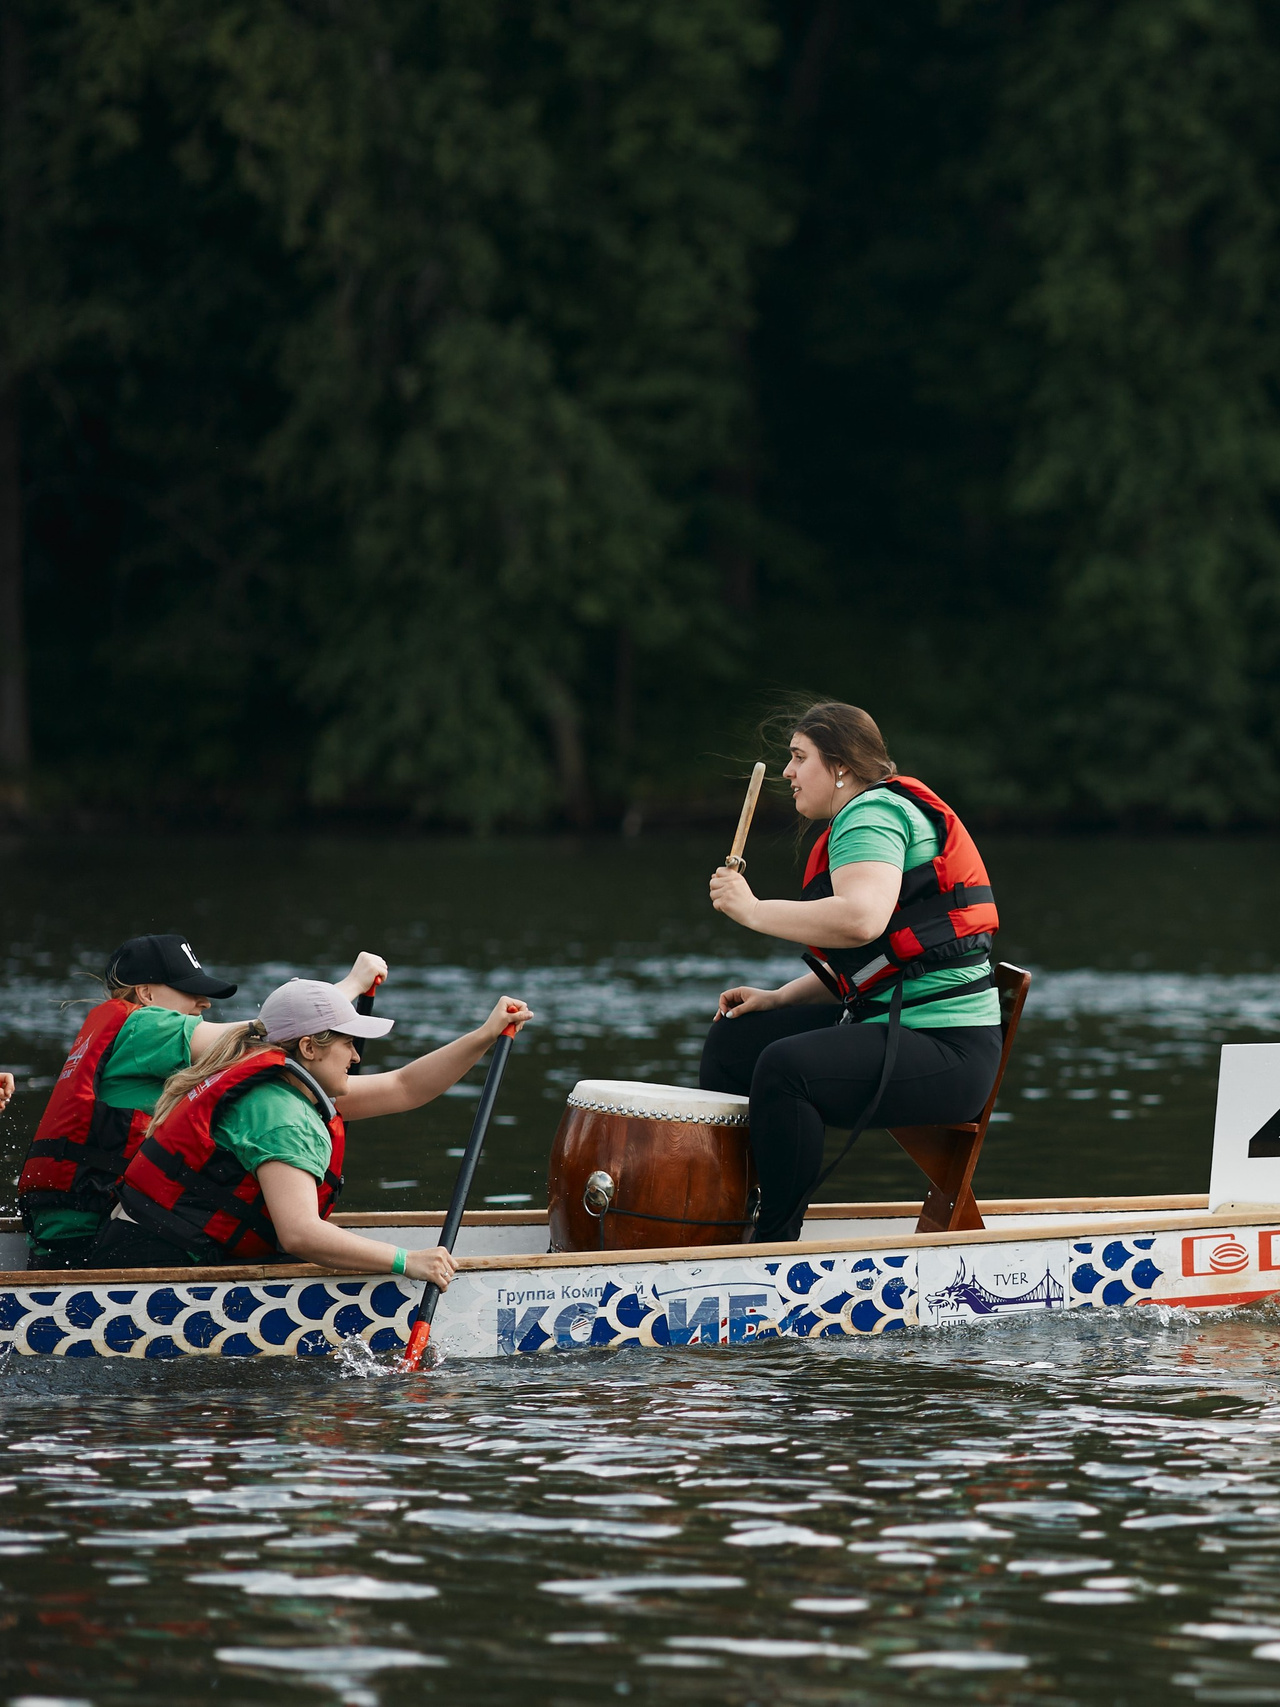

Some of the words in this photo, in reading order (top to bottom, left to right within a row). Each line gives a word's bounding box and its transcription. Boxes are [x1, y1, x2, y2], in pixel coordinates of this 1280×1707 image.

[993, 1272, 1029, 1286] TVER
[497, 1287, 556, 1305] Группа
[561, 1281, 644, 1299] Компй
